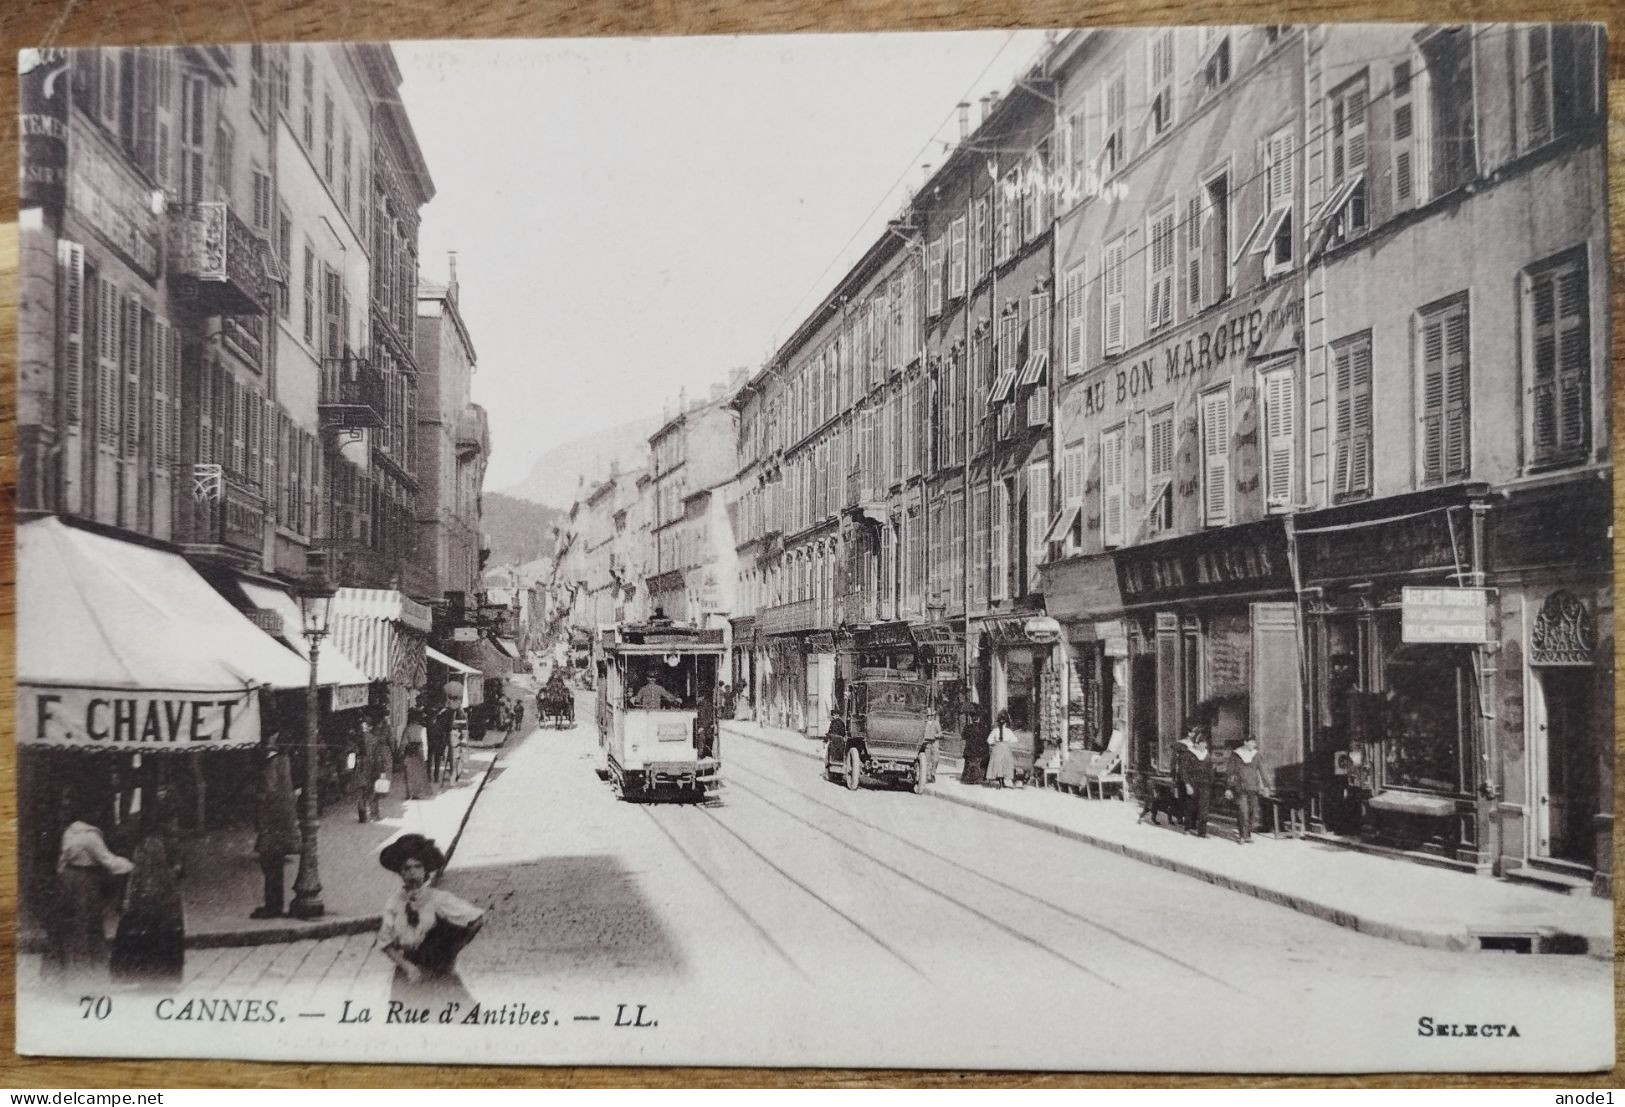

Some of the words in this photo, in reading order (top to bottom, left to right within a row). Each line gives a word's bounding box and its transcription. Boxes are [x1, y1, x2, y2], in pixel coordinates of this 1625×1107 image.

[1084, 382, 1106, 417] AU
[1115, 358, 1154, 405] BON
[36, 694, 72, 739] F.
[86, 698, 240, 742] CHAVET
[80, 996, 112, 1019] 70
[156, 998, 284, 1022] CANNES.
[339, 1001, 371, 1023] La
[386, 1001, 431, 1024] Rue
[614, 1004, 659, 1027] LL.
